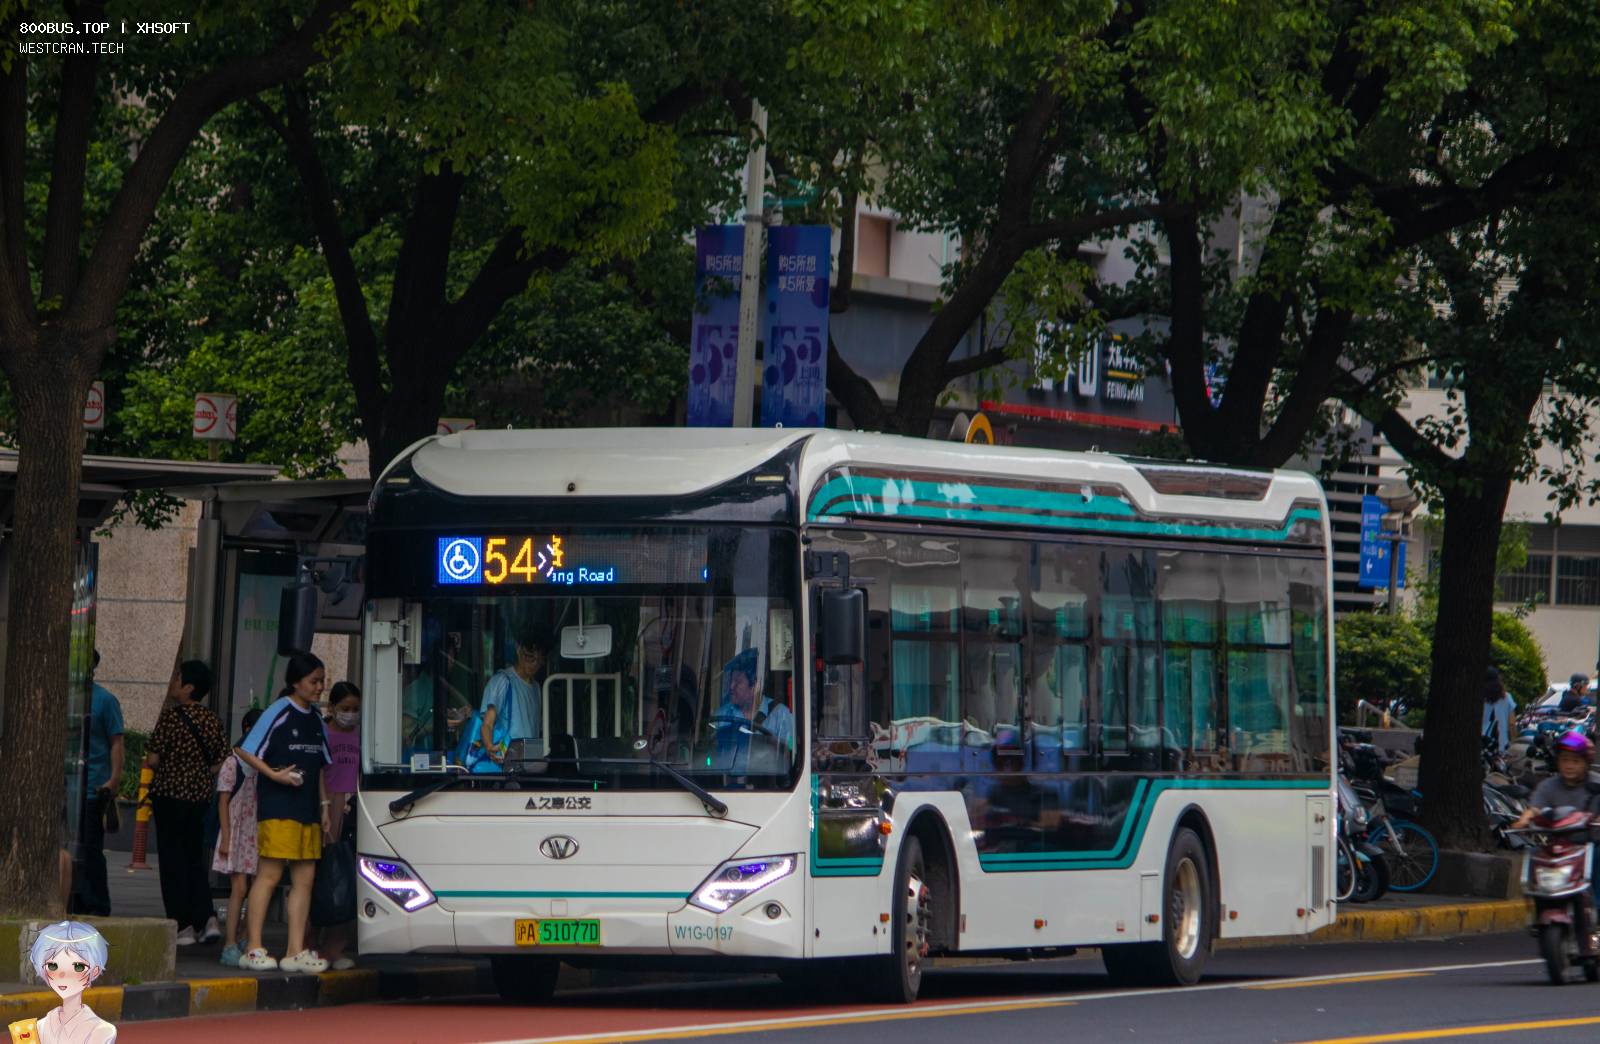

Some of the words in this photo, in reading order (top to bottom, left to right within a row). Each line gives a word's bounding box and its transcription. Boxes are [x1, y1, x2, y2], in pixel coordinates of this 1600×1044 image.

[778, 255, 816, 272] 购5所想
[778, 275, 815, 292] 享5所爱
[484, 538, 537, 584] 54
[579, 567, 613, 582] Road
[543, 922, 598, 942] 51077D
[674, 926, 733, 941] W1G-0197
